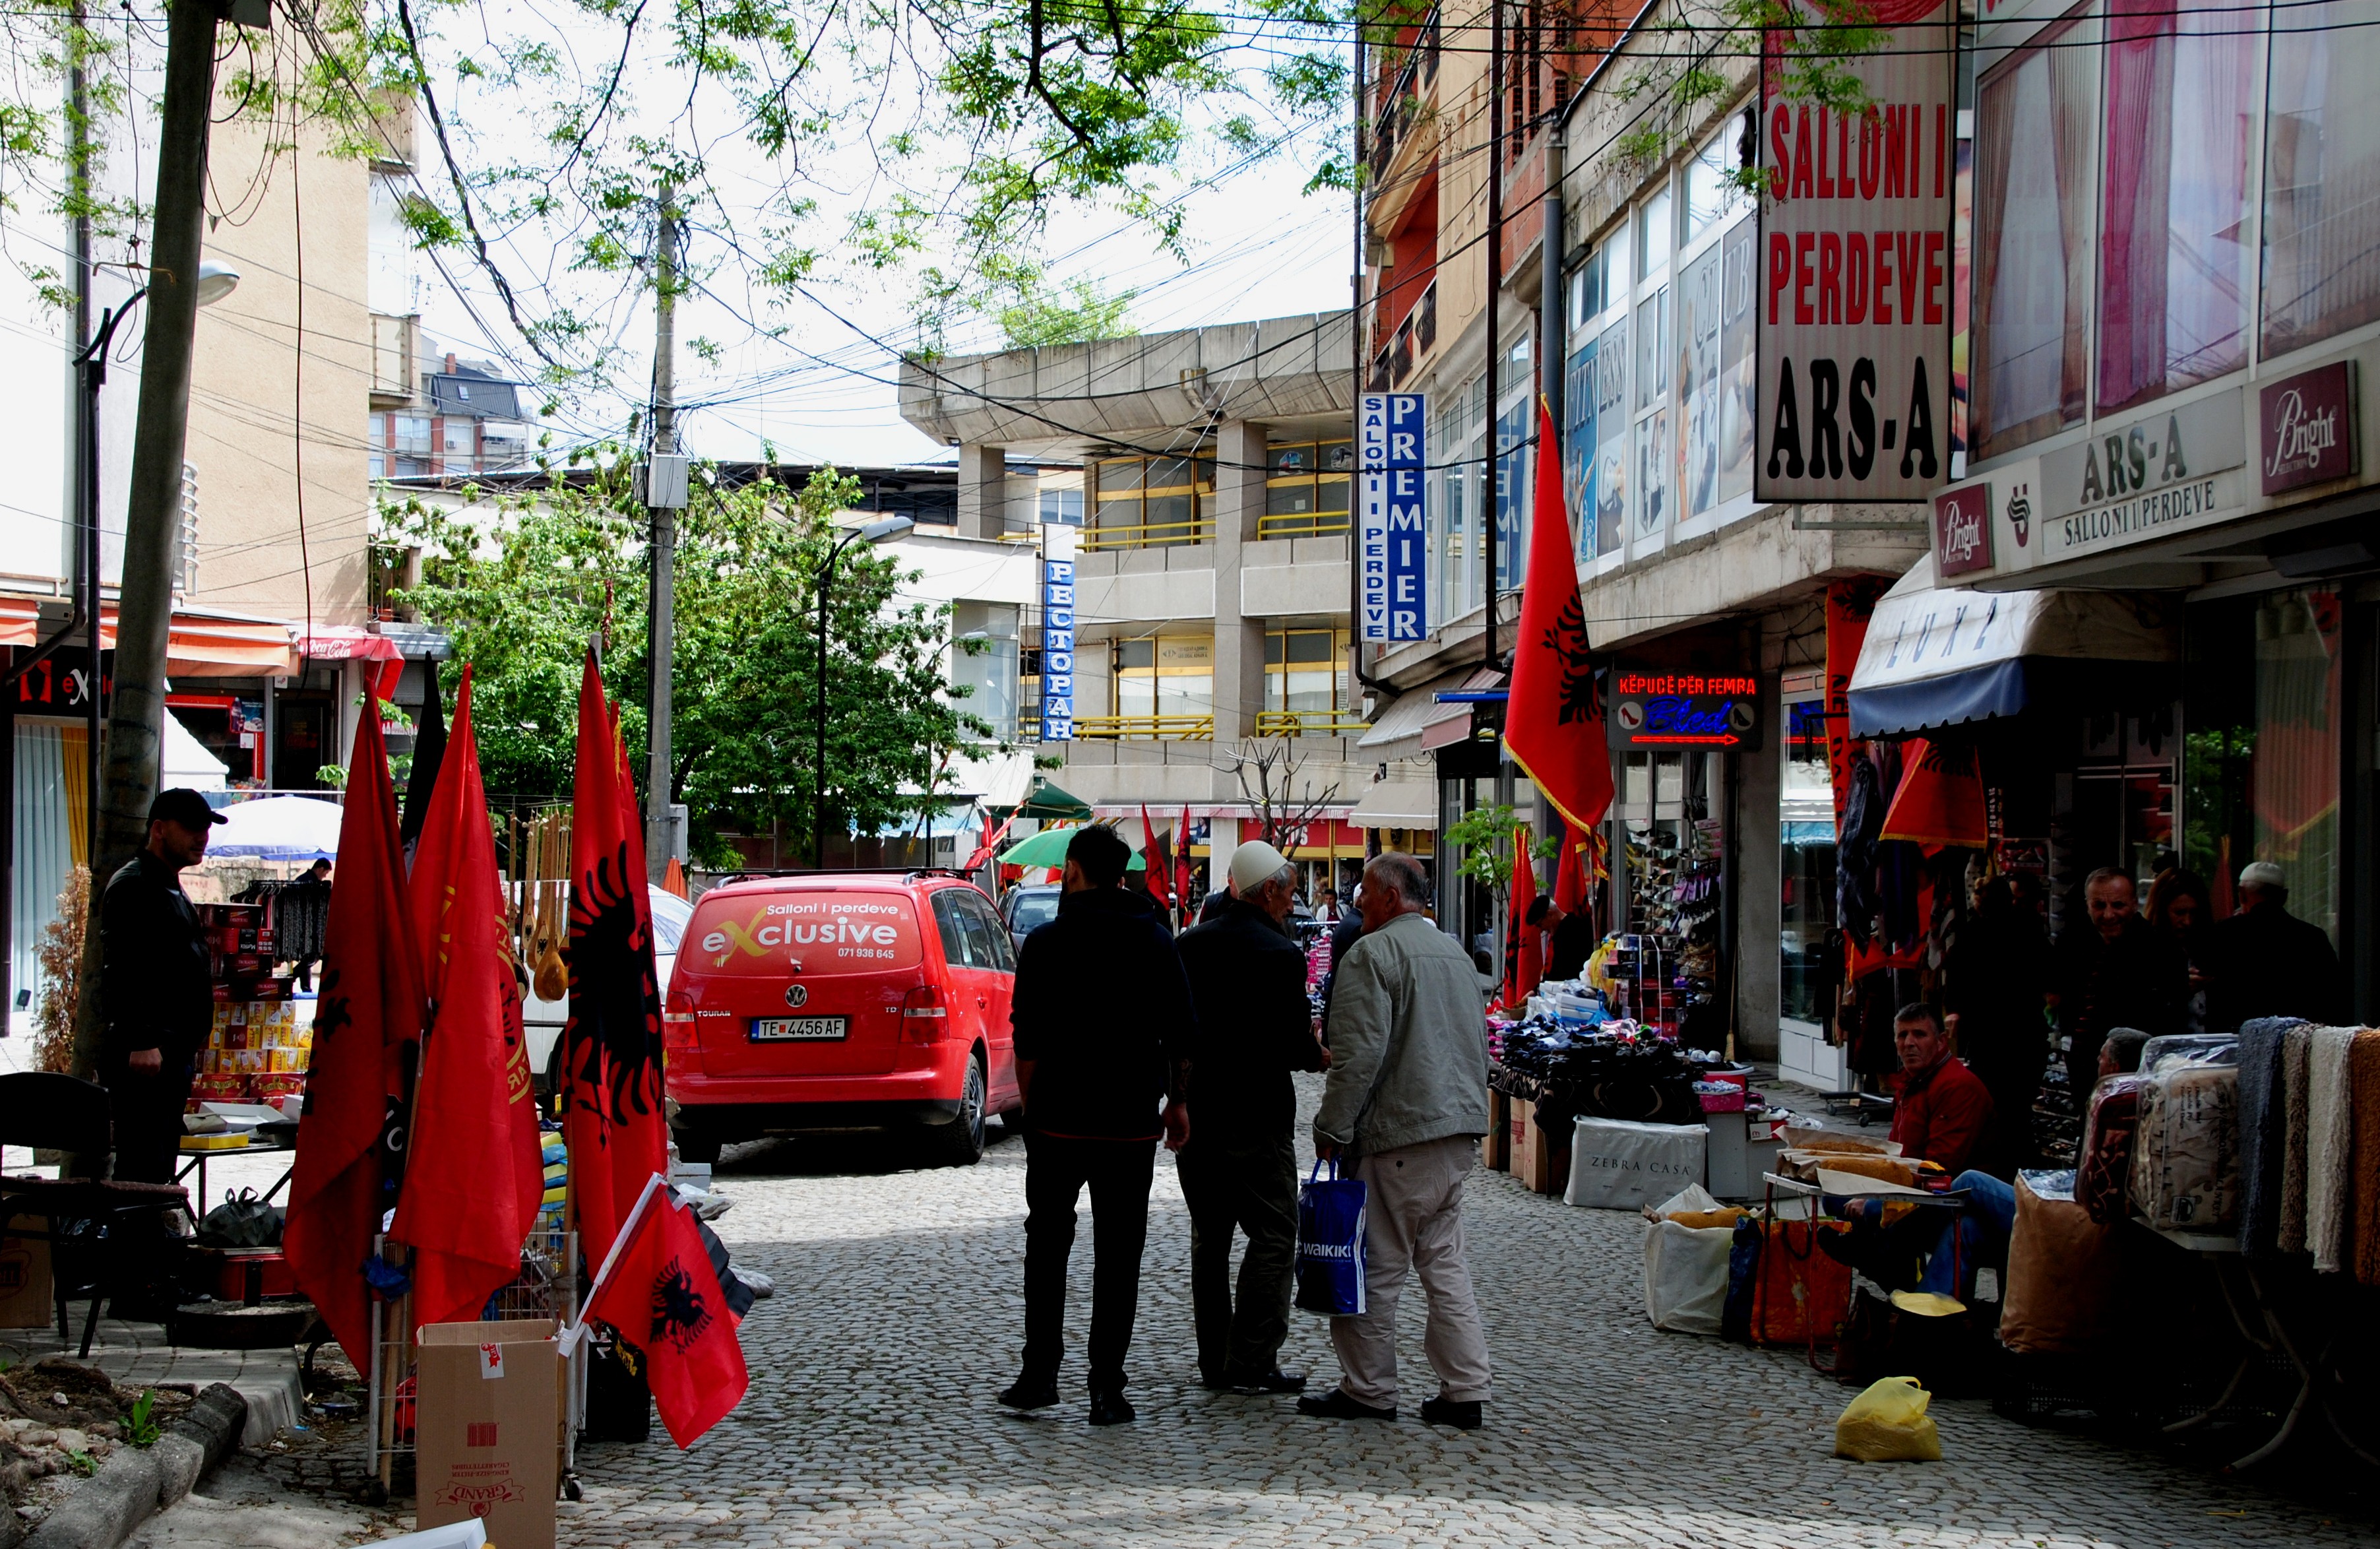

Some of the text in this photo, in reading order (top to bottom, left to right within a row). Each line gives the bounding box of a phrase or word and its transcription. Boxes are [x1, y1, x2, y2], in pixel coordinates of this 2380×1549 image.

[1770, 102, 1920, 200] SALLONI
[1695, 236, 1751, 349] CLUB
[1768, 231, 1943, 325] PERDEVE
[1767, 356, 1937, 481] ARS-A
[2266, 387, 2336, 477] Bright
[1365, 398, 1383, 492] SALONI
[2081, 416, 2186, 505] ARS-A
[1389, 397, 1423, 638] PREMIER
[2065, 504, 2127, 546] SALLONI
[2143, 480, 2215, 526] PERDEVE
[1366, 528, 1384, 637] PERDEVE
[1048, 563, 1072, 739] РЕСТОРАН
[1678, 676, 1703, 695] PËR
[1708, 678, 1756, 695] FEMRA
[1644, 695, 1733, 734] Bled
[1107, 808, 1122, 817] LOTUS
[1164, 808, 1179, 817] LOTUS
[1193, 808, 1209, 817] LOTUS
[1236, 809, 1252, 817] LOTUS
[1327, 809, 1344, 818] LOTUS
[767, 903, 817, 915] Salloni
[831, 903, 898, 915] perdeve
[838, 948, 894, 959] 071 936 645
[762, 1020, 842, 1036] TE 4456 AF
[1592, 1157, 1689, 1176] ZEBRA CASA
[453, 1485, 507, 1501] GRAND
